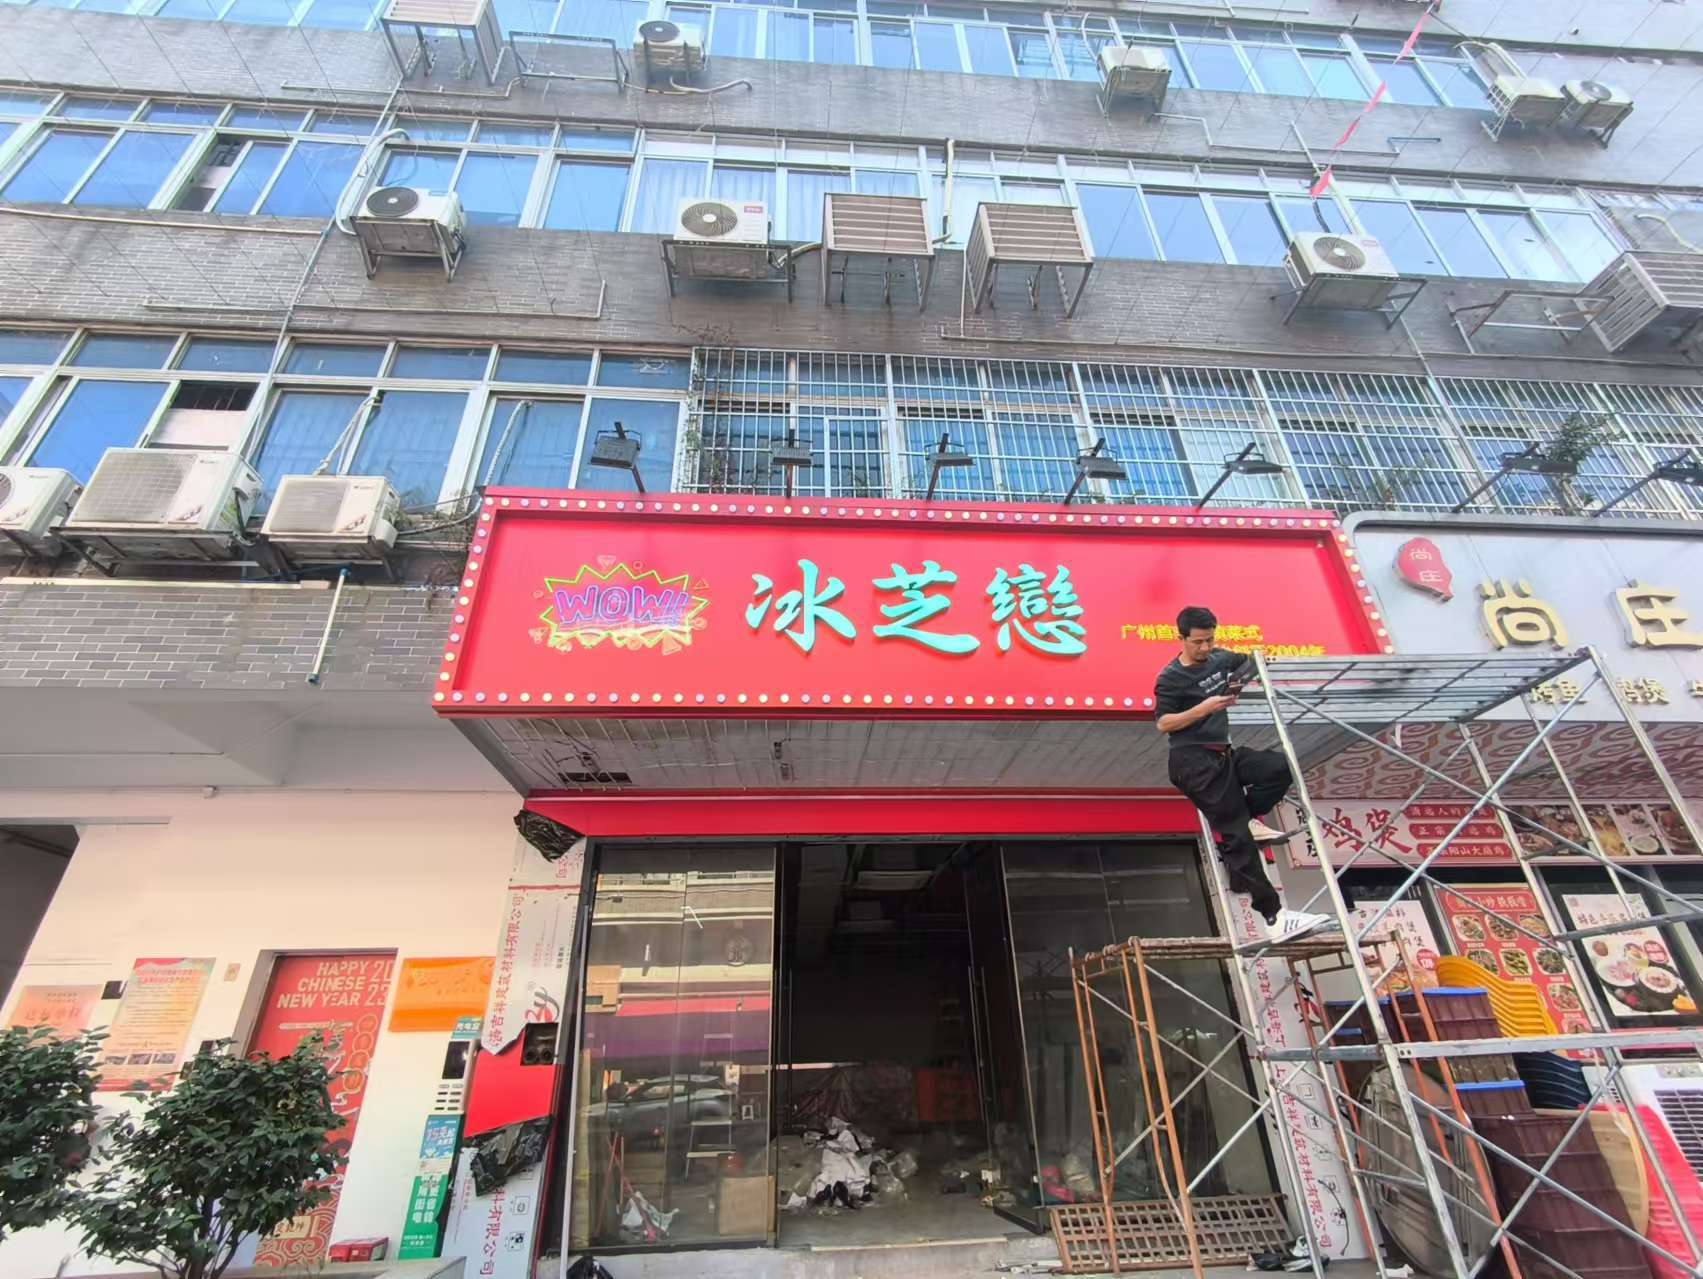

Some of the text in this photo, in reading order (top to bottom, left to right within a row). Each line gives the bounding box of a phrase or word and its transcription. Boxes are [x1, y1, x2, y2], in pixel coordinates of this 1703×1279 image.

[316, 960, 370, 977] HAPPY
[297, 975, 367, 993] CHINESE
[276, 991, 317, 1009] NEW
[321, 991, 362, 1008] YEAR
